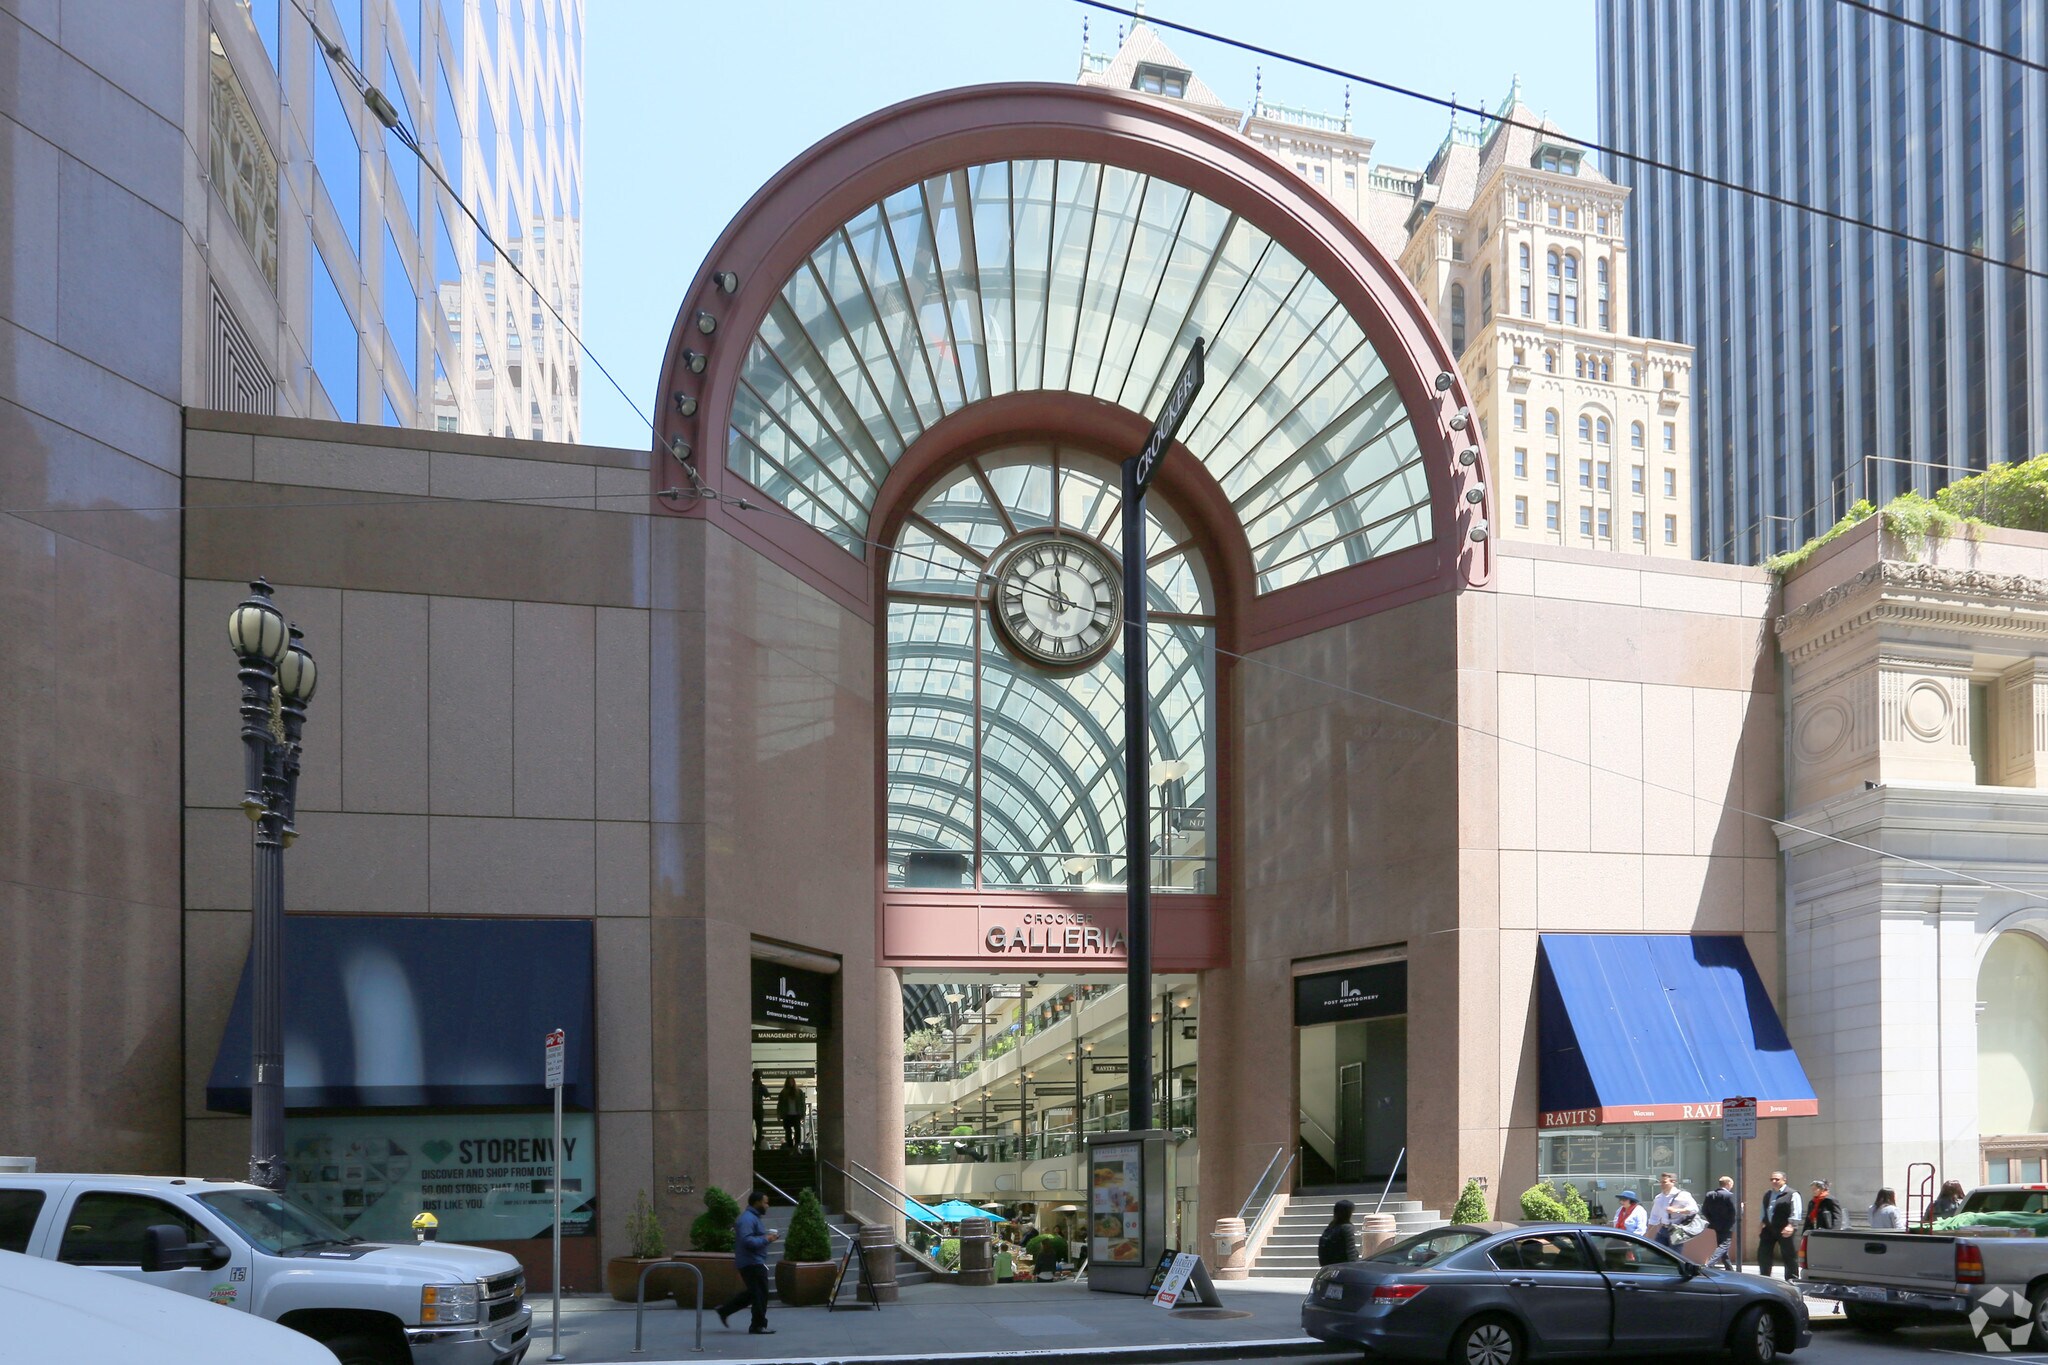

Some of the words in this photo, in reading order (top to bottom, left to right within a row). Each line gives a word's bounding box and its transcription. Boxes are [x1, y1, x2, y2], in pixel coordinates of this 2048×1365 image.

[1137, 370, 1193, 485] CROCKER
[1023, 913, 1094, 925] CROCKER
[985, 925, 1128, 953] GALLERIA
[779, 998, 809, 1007] MONTGOMERY
[1340, 995, 1379, 1003] MONTGOMERY
[1545, 1109, 1596, 1126] RAVITS
[1683, 1104, 1722, 1119] RAVI
[421, 1169, 464, 1180] DISCOVER
[466, 1168, 484, 1178] AND
[486, 1167, 508, 1178] SHOP
[510, 1167, 535, 1177] FROM
[536, 1166, 554, 1176] OVE
[455, 1184, 488, 1194] STORES
[490, 1183, 511, 1193] THAT
[514, 1182, 531, 1193] ARE
[423, 1200, 443, 1210] JUST
[445, 1199, 463, 1209] LIKE
[466, 1199, 485, 1209] YOU.
[232, 1271, 244, 1281] 15
